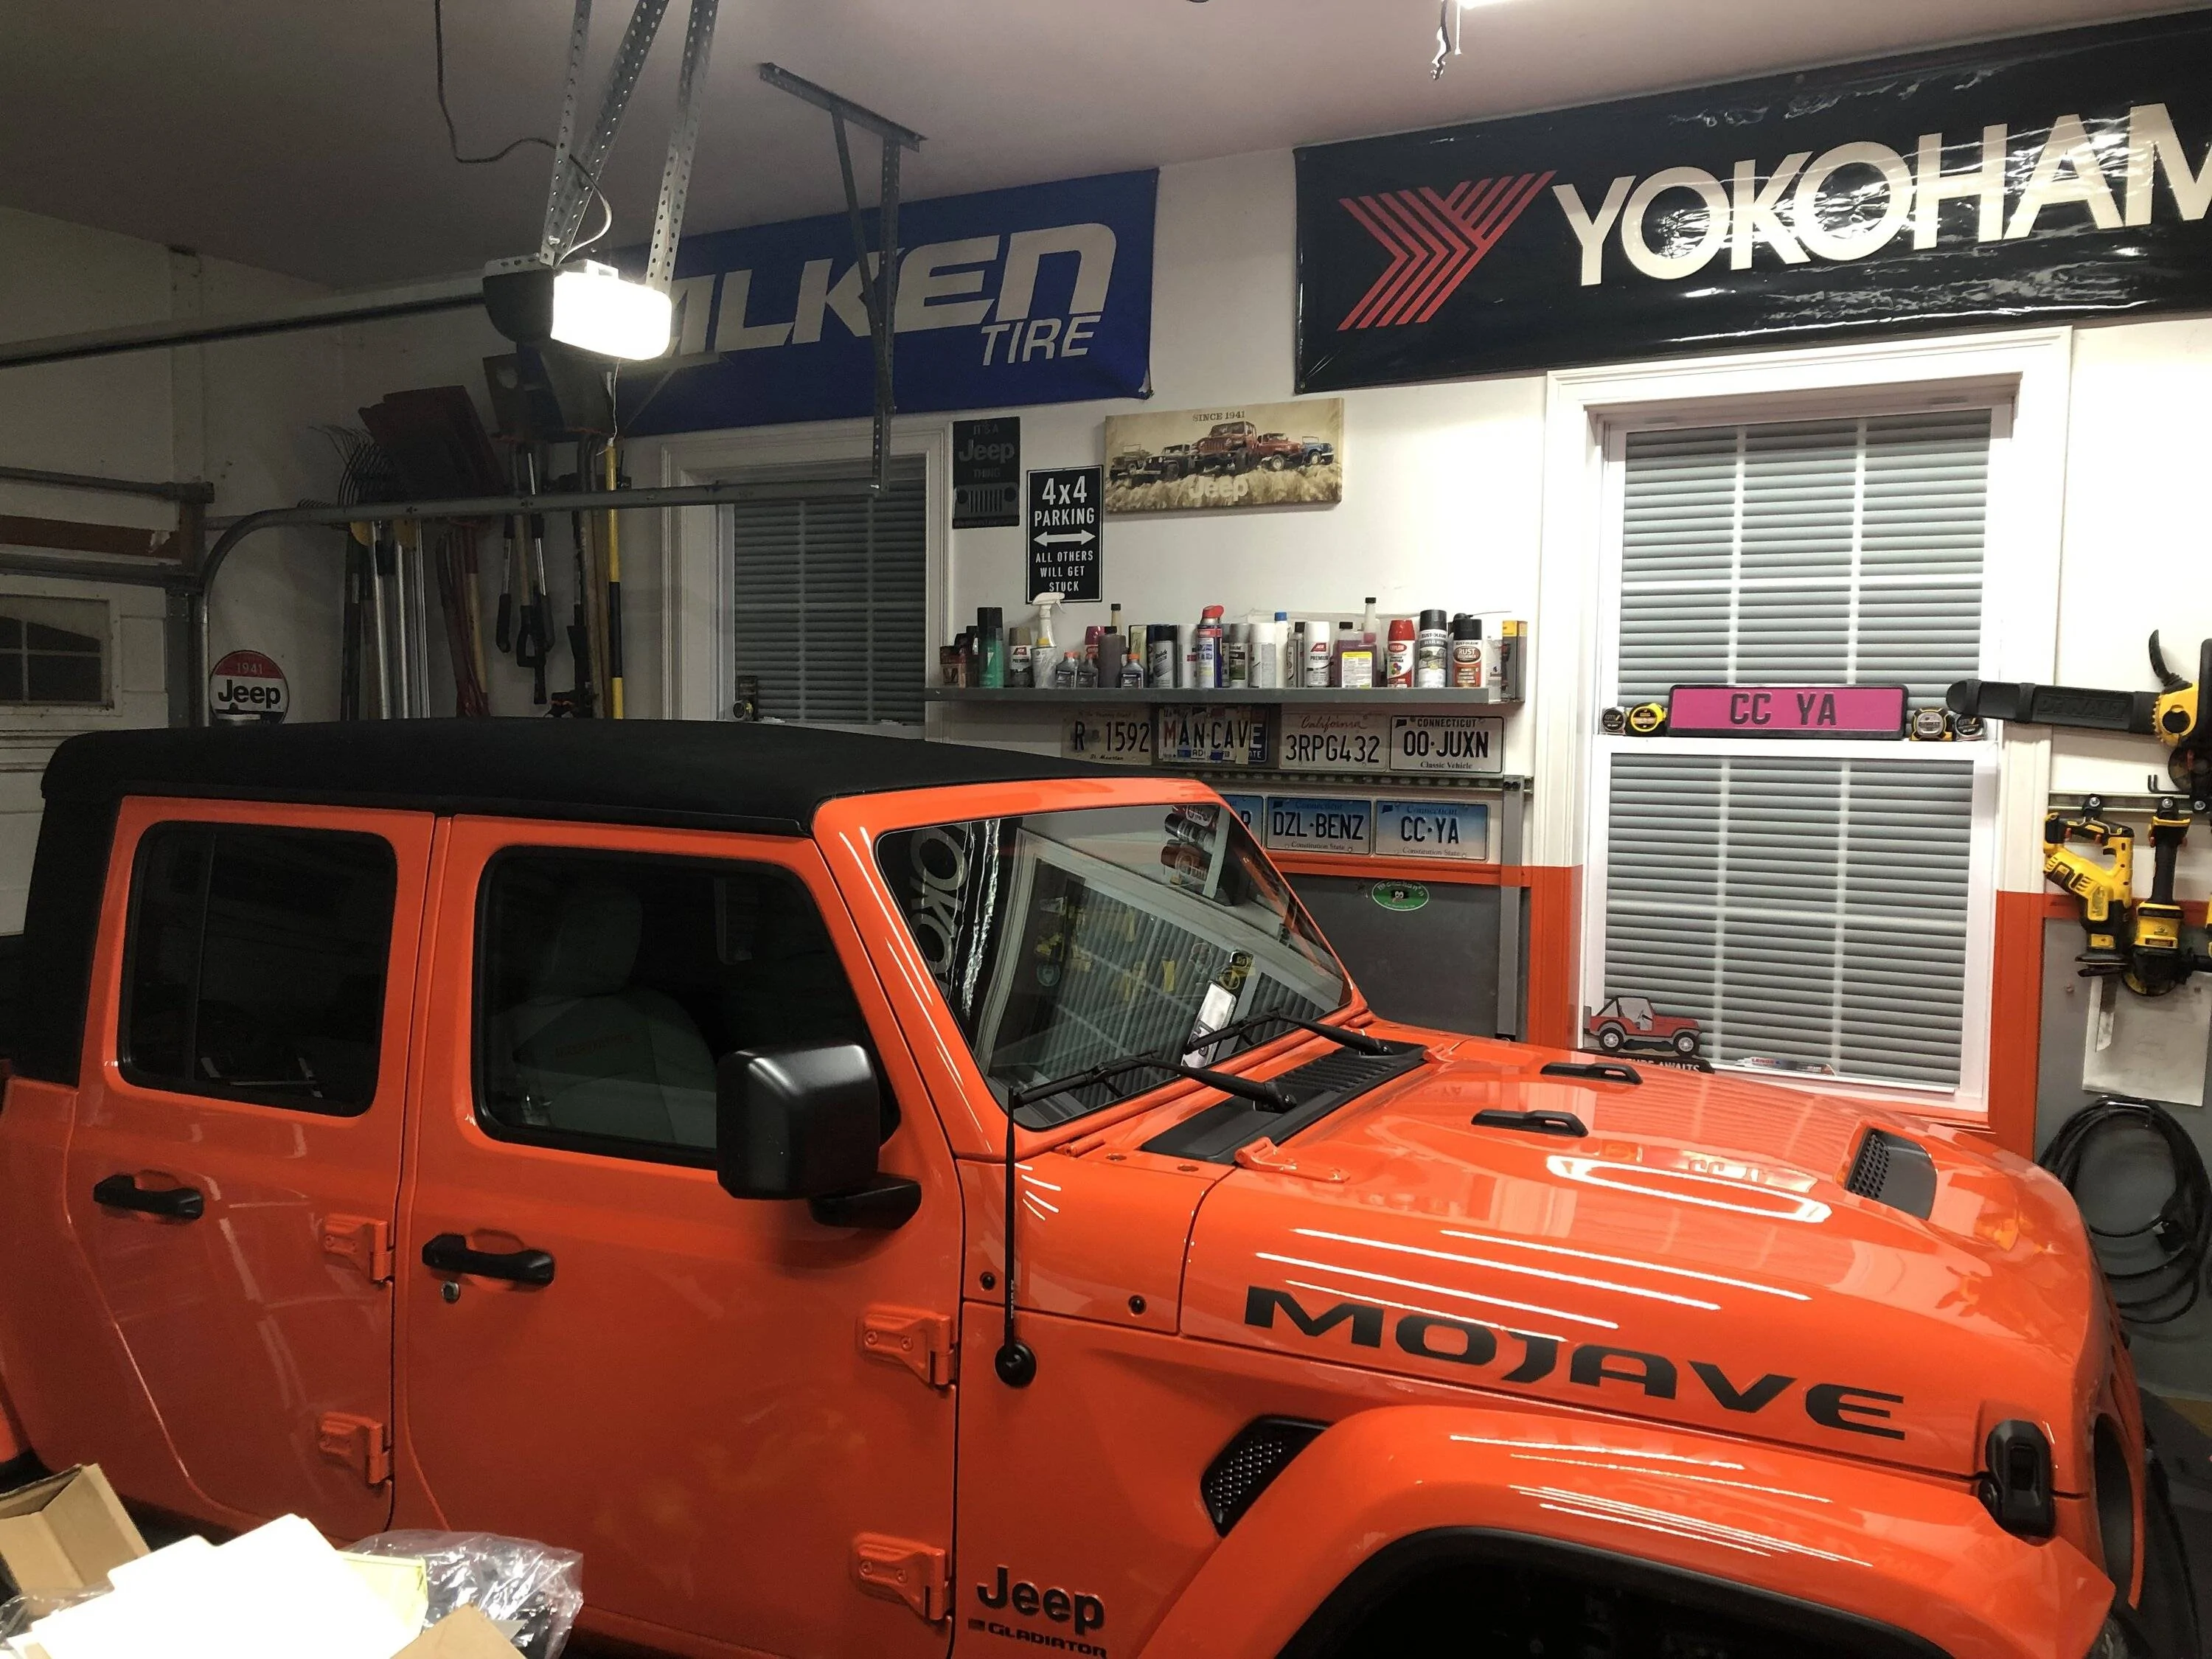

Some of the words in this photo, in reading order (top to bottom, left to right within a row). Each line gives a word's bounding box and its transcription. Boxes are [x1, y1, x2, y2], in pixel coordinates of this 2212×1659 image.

[664, 223, 1117, 358] ALKEN
[980, 315, 1102, 366] TIRE
[1192, 412, 1222, 422] SINCE
[1225, 411, 1246, 420] 1941
[959, 439, 1015, 464] Jeep
[1042, 476, 1088, 506] 4x4
[1188, 476, 1249, 502] Jeep
[1034, 507, 1095, 527] PARKING
[1035, 552, 1053, 563] ALL
[1057, 550, 1093, 563] OTHERS
[1040, 566, 1062, 577] WILL
[1068, 566, 1085, 577] GET
[1049, 581, 1079, 592] STUCK
[237, 663, 263, 675] 1941
[218, 679, 281, 709] Jeep
[1730, 692, 1773, 725] CC
[1797, 692, 1837, 726] YA
[1301, 714, 1366, 732] California
[1417, 718, 1477, 728] CONNECTICUT
[1107, 720, 1150, 753] 1592
[1285, 734, 1380, 763] 3RPG432
[1420, 761, 1444, 769] Classic
[1447, 761, 1472, 770] Vehicle
[1244, 1285, 1906, 1441] MOJAVE
[977, 1564, 1105, 1635] Jeep
[988, 1621, 1108, 1659] GLADIATOR
